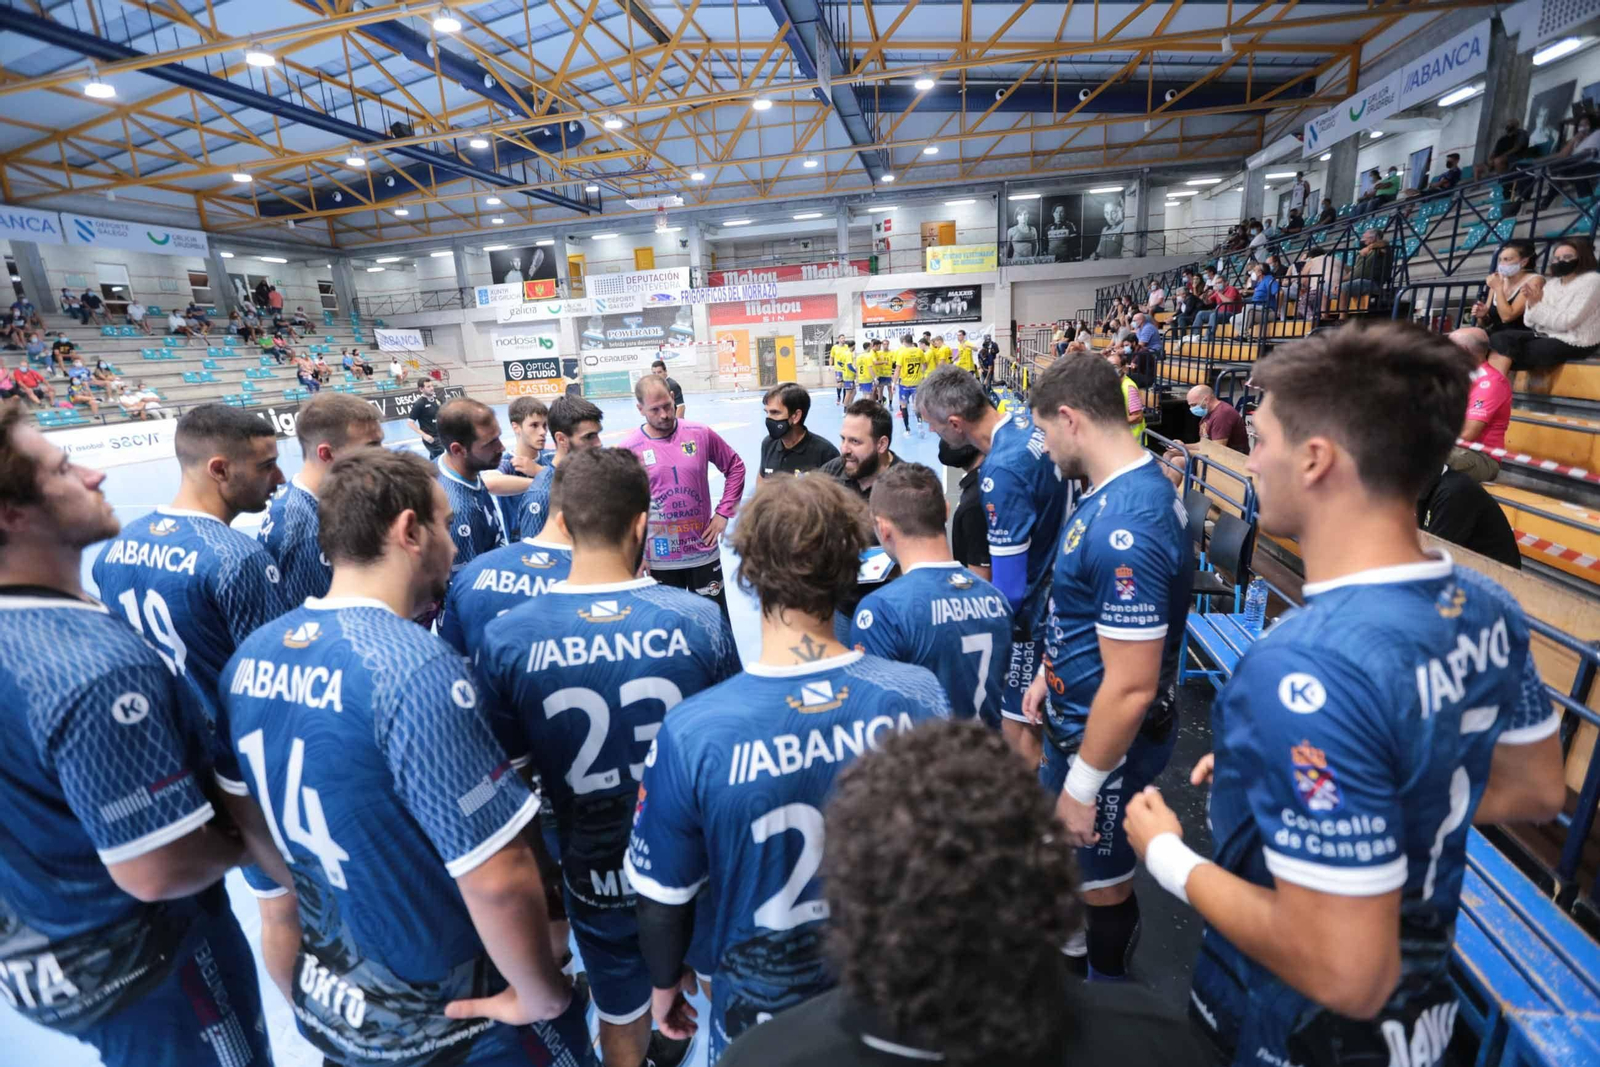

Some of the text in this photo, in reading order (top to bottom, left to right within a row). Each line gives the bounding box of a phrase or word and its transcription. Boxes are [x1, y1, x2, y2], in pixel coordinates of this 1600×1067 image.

[97, 229, 128, 238] GALEGO
[626, 271, 680, 284] DEPUTACIÓN
[723, 270, 778, 287] Mahou
[627, 281, 681, 293] PONTEVEDRA
[680, 287, 727, 304] FRIGORIFICOS
[728, 285, 741, 301] DEL
[742, 283, 778, 300] MORRAZO
[607, 295, 636, 304] DEPORTE
[608, 302, 635, 310] GALEGO
[745, 300, 802, 316] Mahou
[763, 315, 785, 323] SIN
[607, 327, 662, 339] POWERADE
[496, 335, 537, 347] nodosa
[525, 361, 556, 371] ÓPTICA
[907, 362, 920, 375] 27
[527, 370, 557, 379] STUDIO
[520, 383, 558, 394] CASTRO
[672, 465, 679, 485] 1
[672, 500, 687, 509] DEL
[659, 508, 700, 520] MORRAZO
[1102, 602, 1156, 613] Concello
[1101, 611, 1160, 625] de Cangas
[1020, 641, 1035, 694] DEPORTE
[961, 633, 993, 722] 7
[542, 676, 684, 795] 23
[238, 728, 350, 891] 14
[1098, 795, 1120, 856] DEPORTE
[1282, 808, 1386, 837] Concello
[1275, 828, 1397, 862] de Cangas
